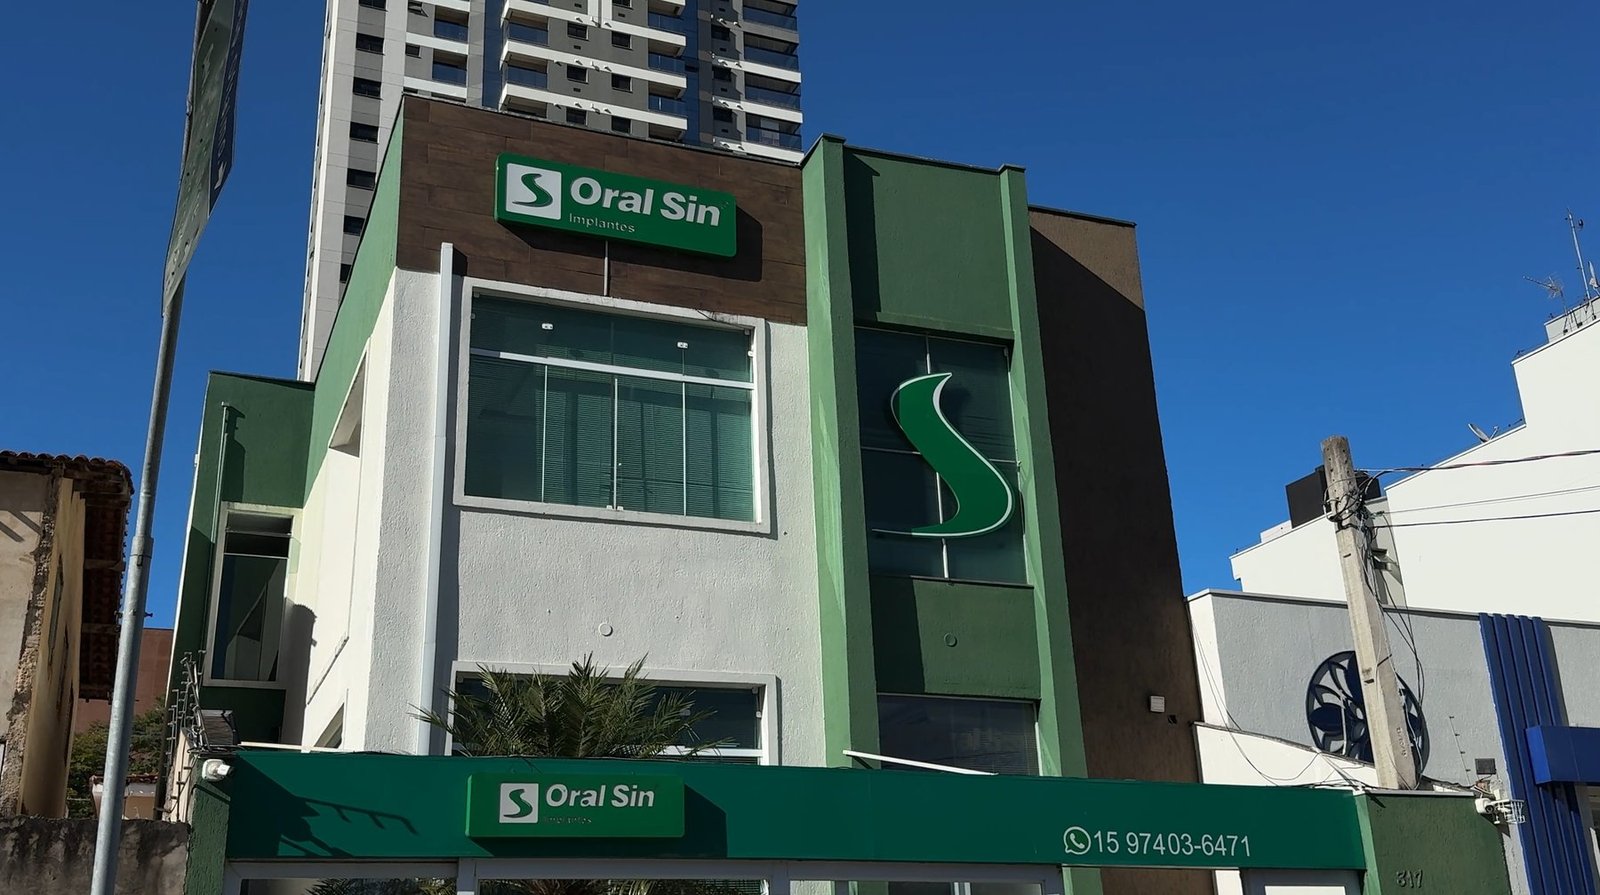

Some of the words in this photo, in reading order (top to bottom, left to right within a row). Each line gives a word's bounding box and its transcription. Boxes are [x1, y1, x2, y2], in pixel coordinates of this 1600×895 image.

[569, 176, 654, 216] Oral
[660, 191, 720, 227] Sin
[568, 212, 636, 234] Implantes
[545, 783, 606, 808] Oral
[611, 784, 655, 808] Sin
[1093, 830, 1120, 854] 15
[1126, 831, 1251, 857] 97403-6471
